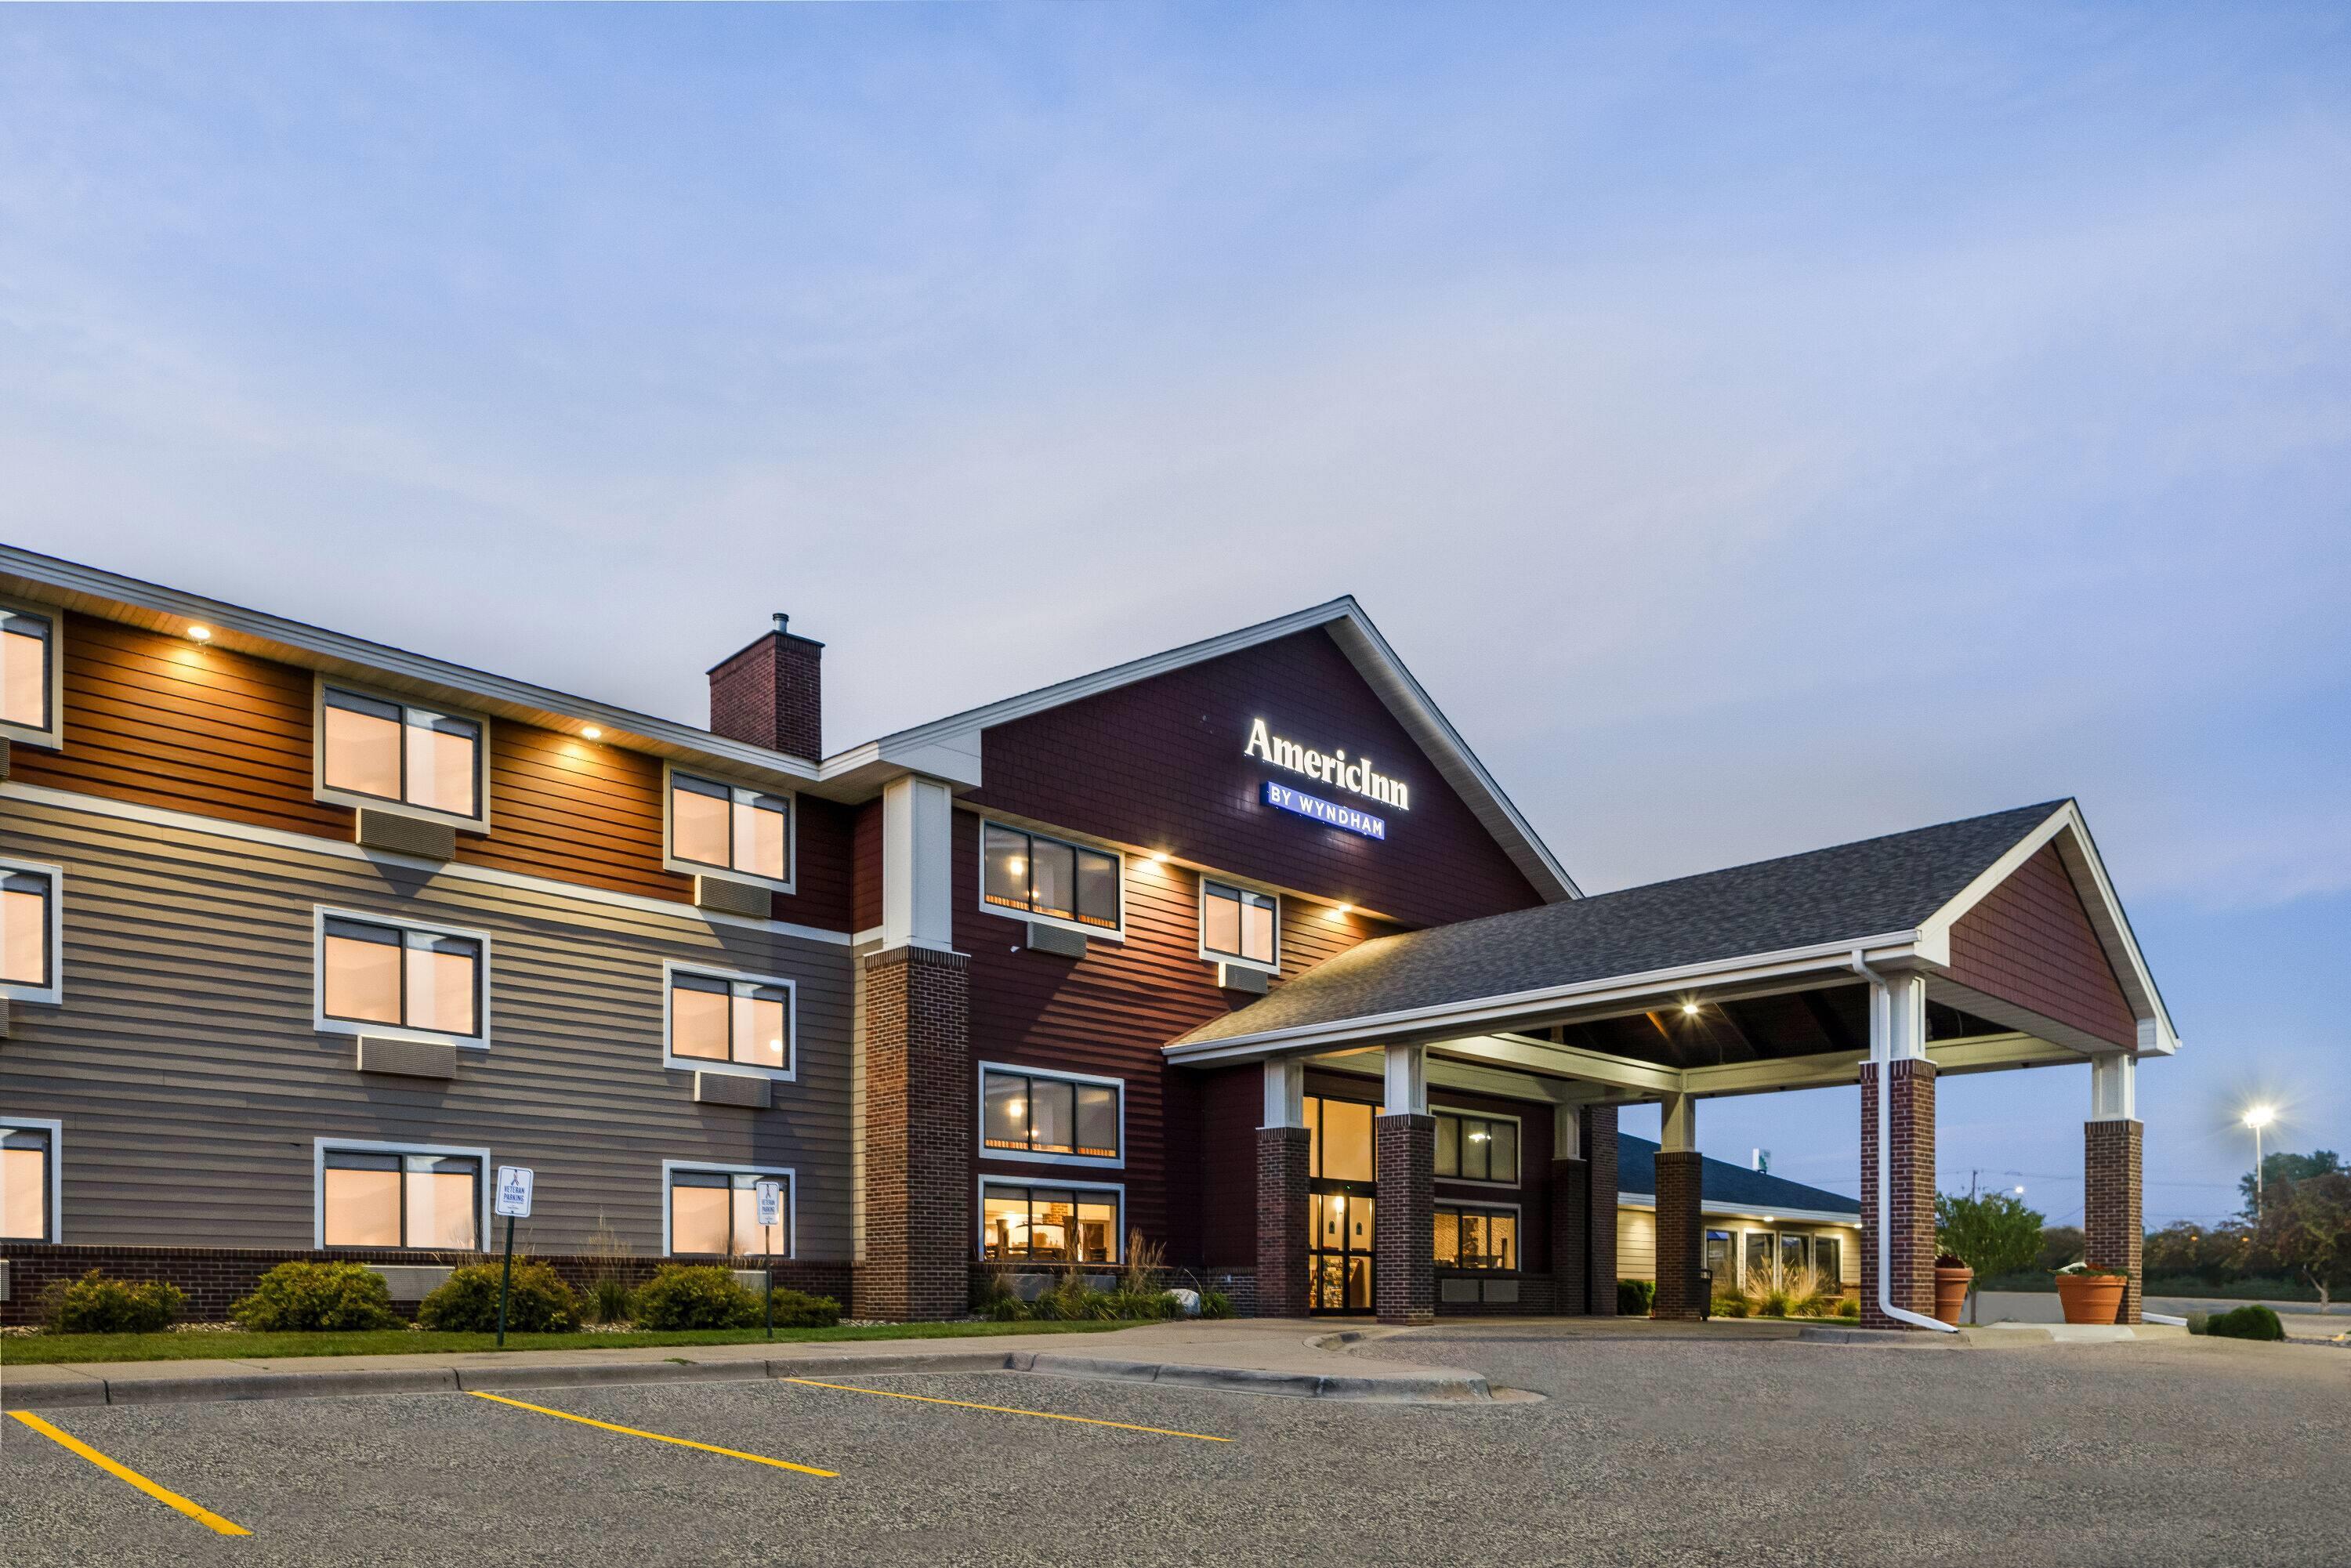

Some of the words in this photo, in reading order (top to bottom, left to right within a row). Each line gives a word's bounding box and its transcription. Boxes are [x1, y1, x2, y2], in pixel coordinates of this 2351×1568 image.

[1244, 718, 1409, 811] AmericInn
[1271, 785, 1291, 806] BY
[1299, 795, 1382, 836] WYNDHAM
[503, 1193, 524, 1202] PARKING
[504, 1186, 525, 1194] VETERAN
